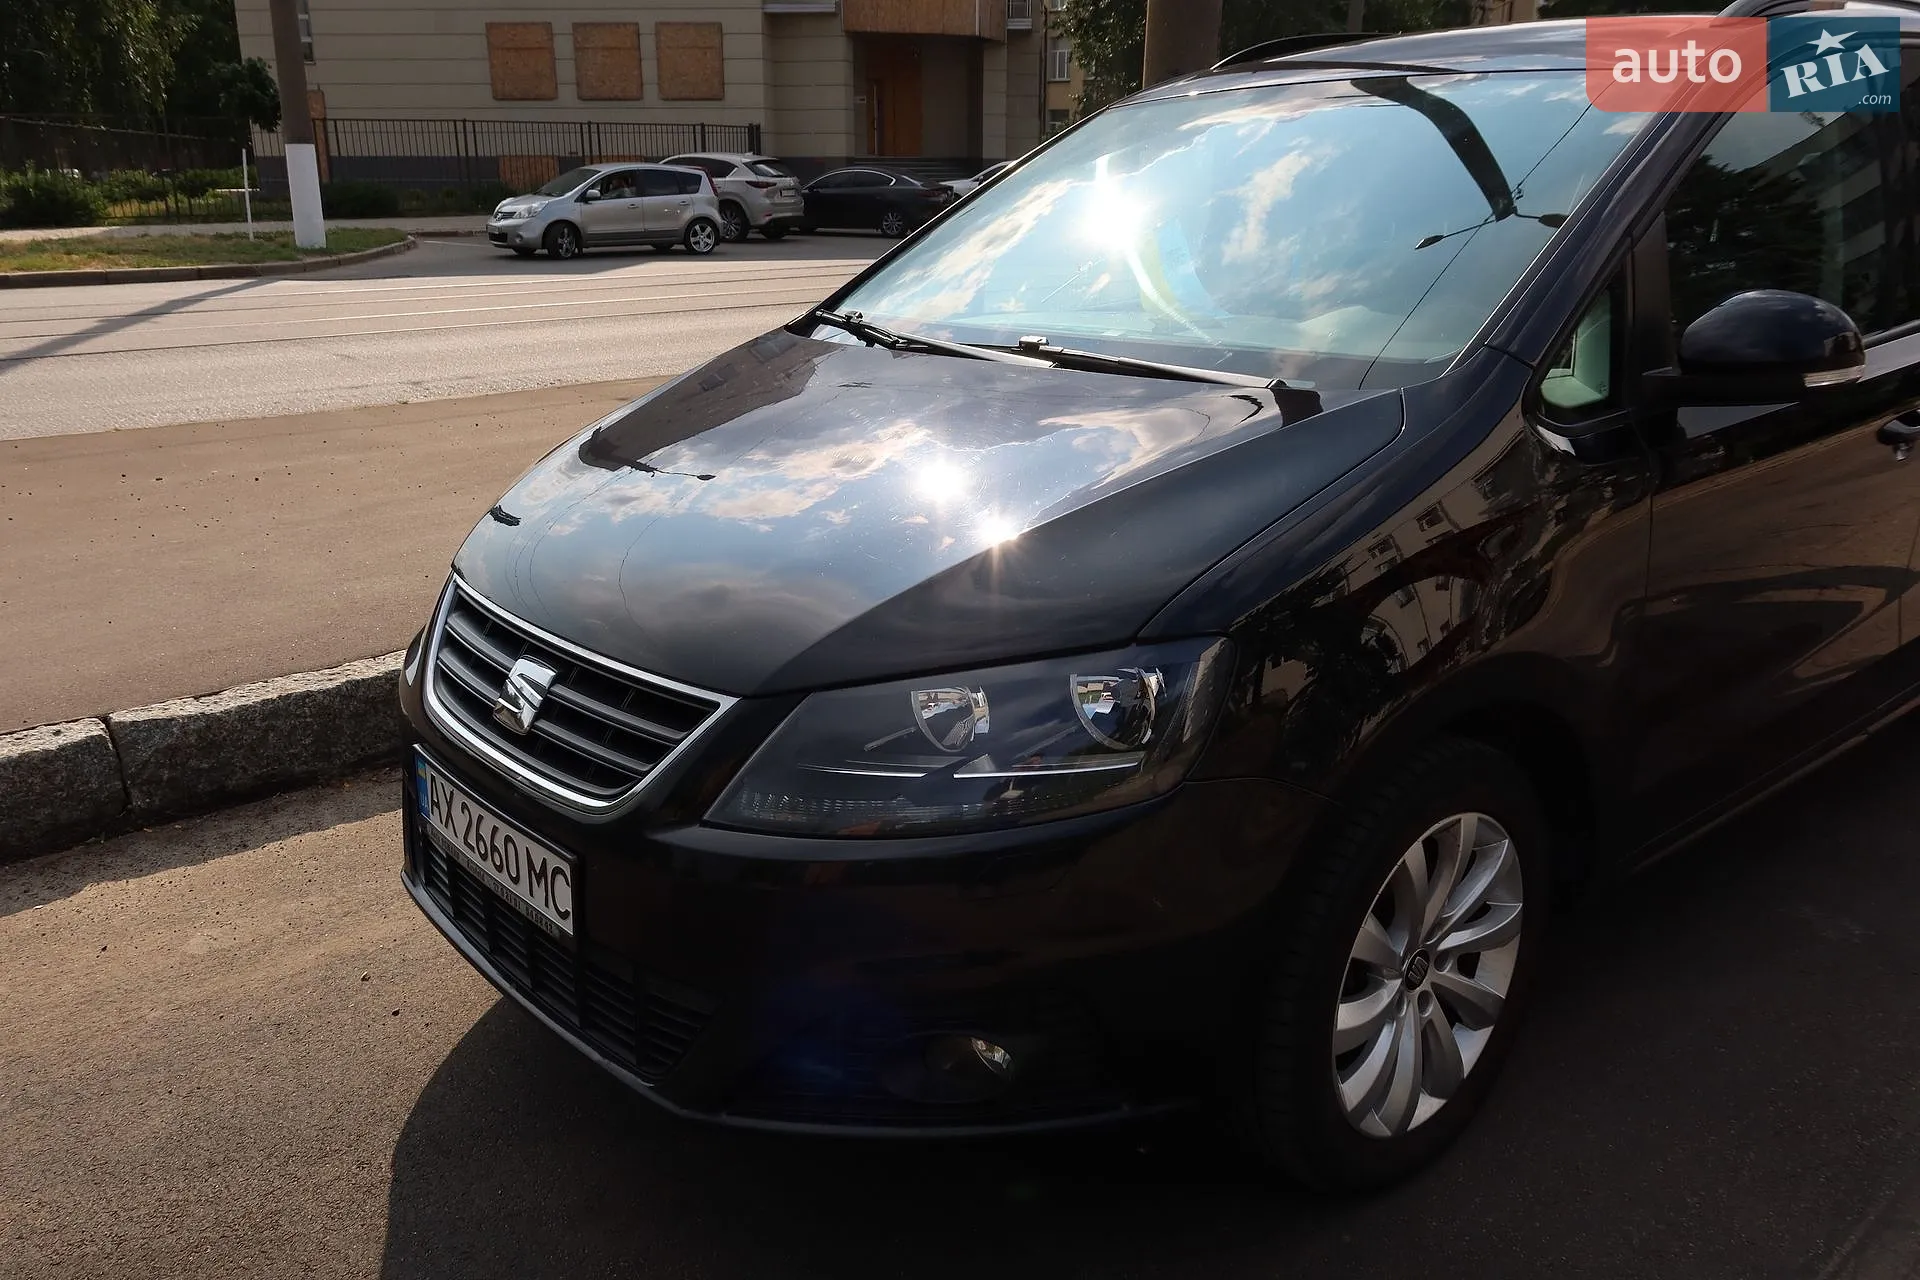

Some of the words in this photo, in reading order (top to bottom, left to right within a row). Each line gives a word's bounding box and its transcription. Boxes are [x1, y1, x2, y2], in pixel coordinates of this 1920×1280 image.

[430, 772, 458, 839] AX
[460, 801, 520, 886] 2660
[525, 845, 571, 921] MC
